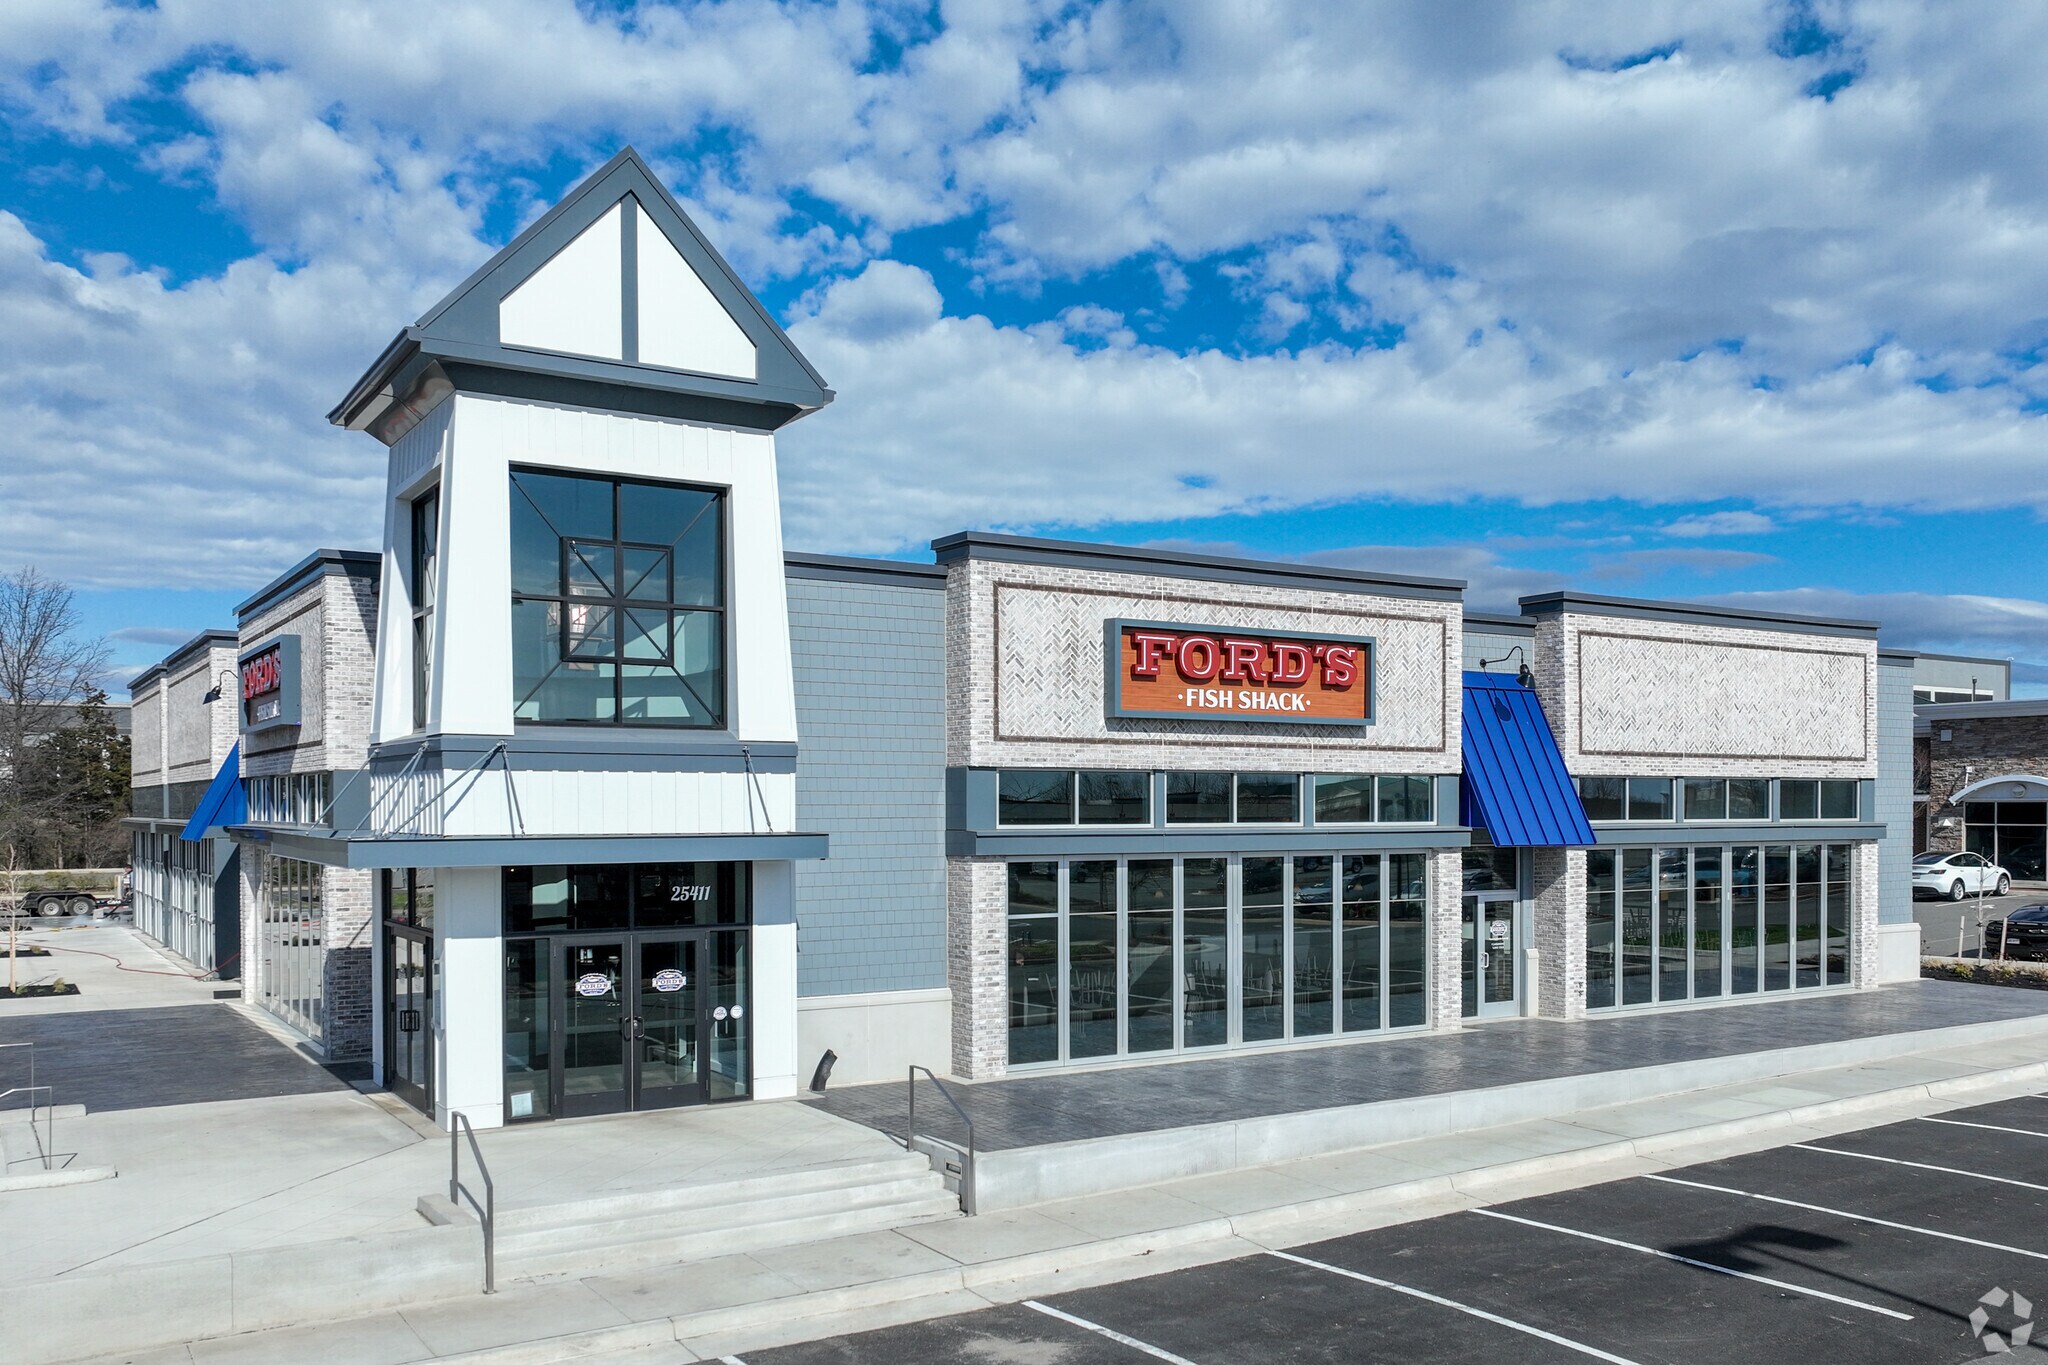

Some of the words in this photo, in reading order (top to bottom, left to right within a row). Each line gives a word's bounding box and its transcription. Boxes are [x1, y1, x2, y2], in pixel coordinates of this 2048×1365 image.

[1131, 632, 1358, 690] FORD'S
[1186, 688, 1233, 708] FISH
[1238, 691, 1306, 711] SHACK
[670, 885, 711, 901] 25411
